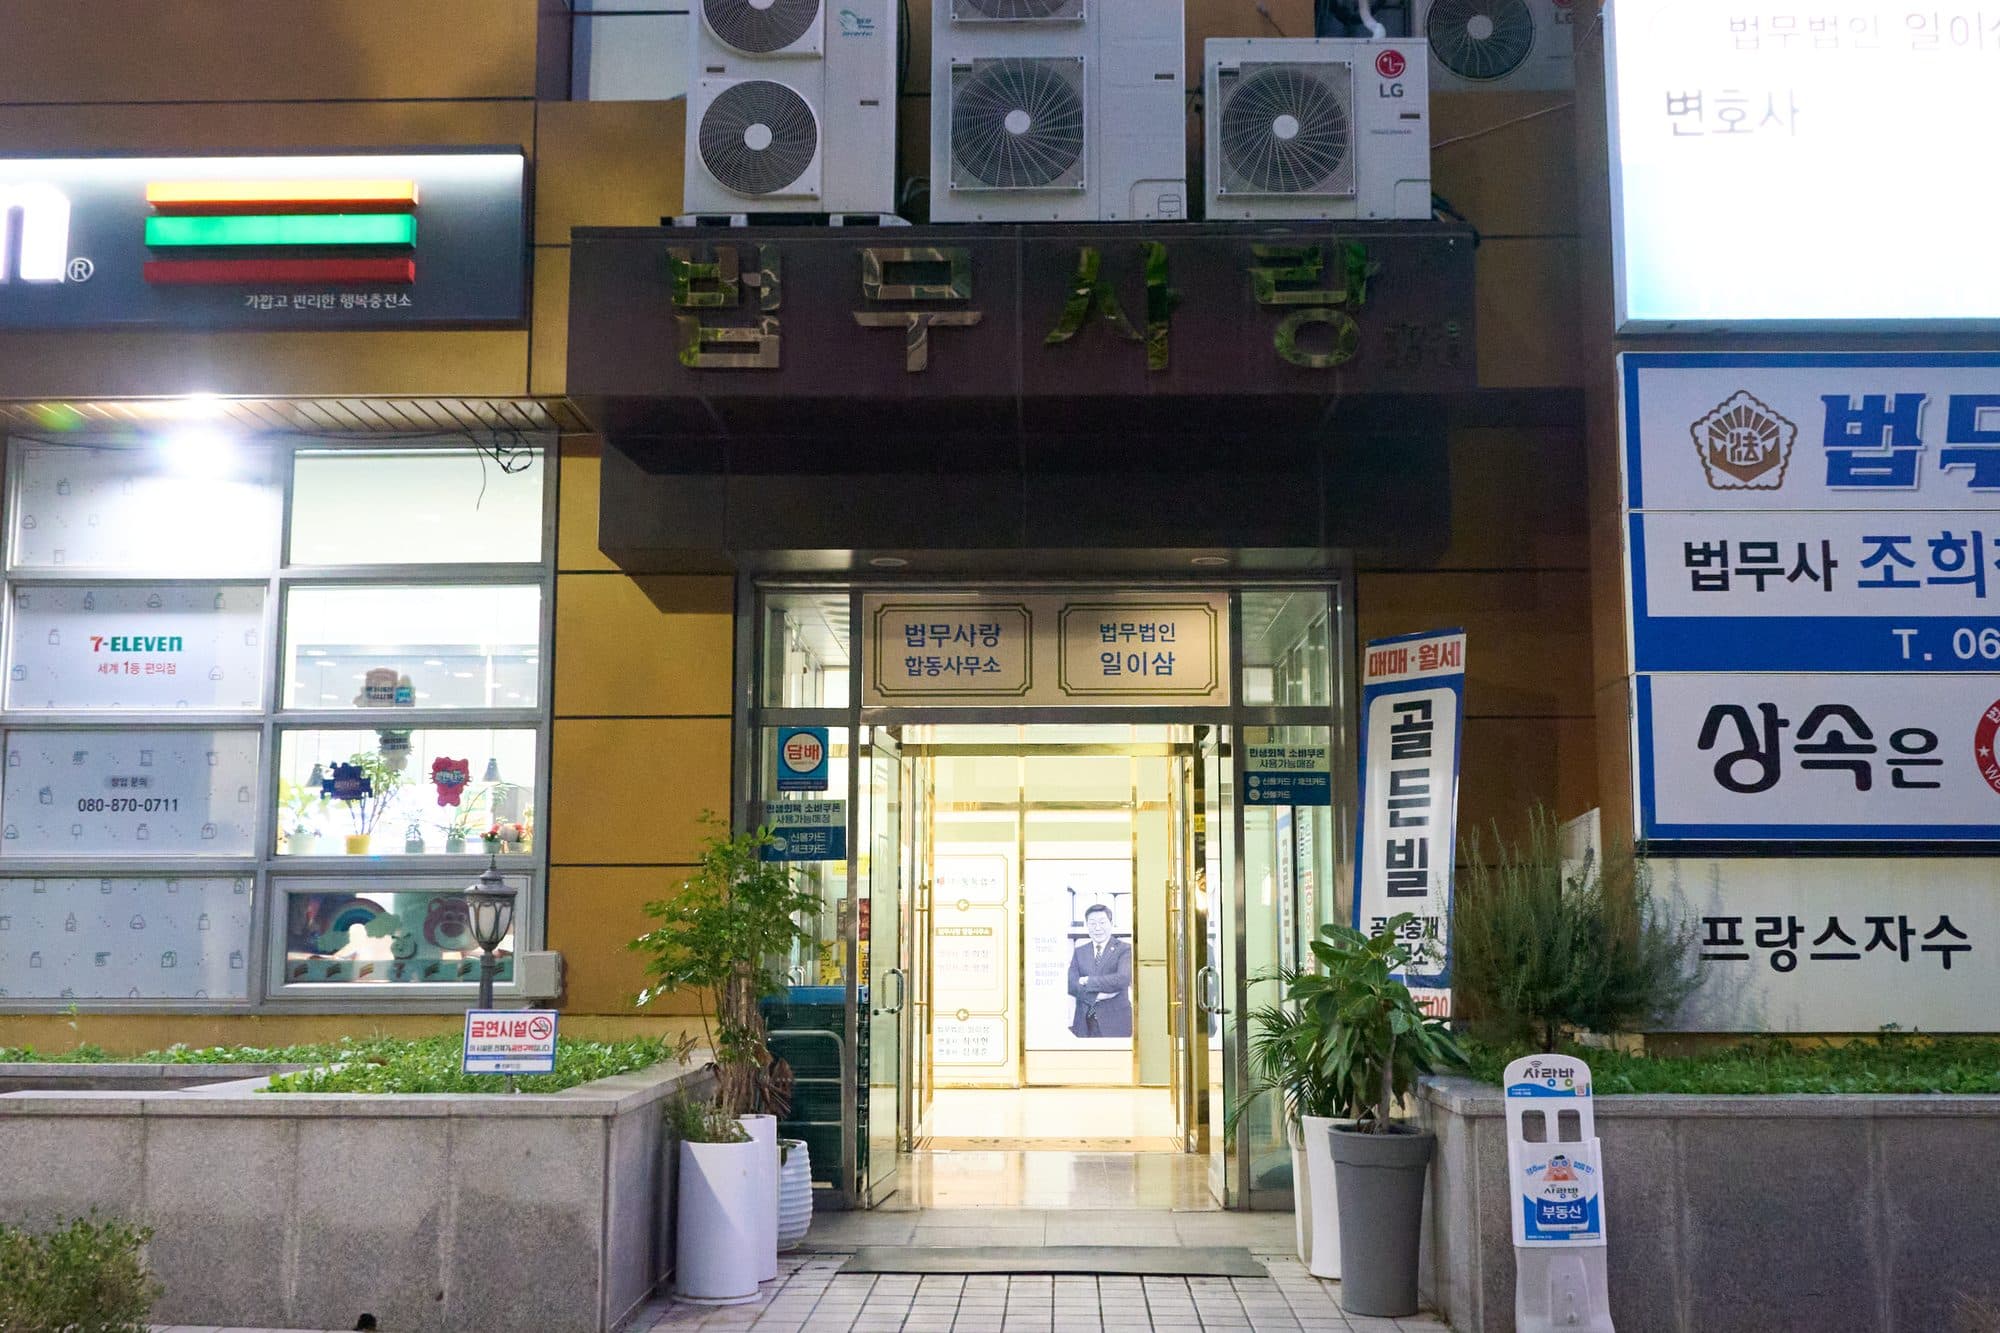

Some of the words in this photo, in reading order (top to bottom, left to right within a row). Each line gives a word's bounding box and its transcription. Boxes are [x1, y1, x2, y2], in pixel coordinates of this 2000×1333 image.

[1729, 15, 1880, 49] 법무법인
[1380, 83, 1403, 98] LG
[1666, 89, 1799, 136] 변호사
[245, 293, 289, 310] 가깝고
[293, 293, 335, 309] 편리한
[340, 292, 413, 309] 행복충전소
[666, 240, 1382, 371] 법무사랑
[1684, 539, 1838, 592] 법무사
[1858, 530, 2000, 598] 조희
[904, 623, 1000, 648] 법무사랑
[1100, 623, 1176, 643] 법무법인
[1892, 629, 1933, 661] T.
[98, 662, 120, 675] 세계
[124, 661, 141, 675] 1등
[145, 663, 176, 675] 편의점
[905, 656, 1002, 676] 합동사무소
[1100, 651, 1176, 676] 일이삼
[787, 744, 820, 760] 담배
[1697, 702, 1943, 793] 상속은
[78, 798, 178, 812] 080-870-0711
[1386, 699, 1434, 897] 골드빌
[1702, 915, 1972, 972] 프랑스자수
[471, 1020, 527, 1038] 금연시설
[1523, 1067, 1574, 1087] 사랑방
[1544, 1187, 1579, 1199] 사랑방
[1542, 1205, 1582, 1219] 부동산
